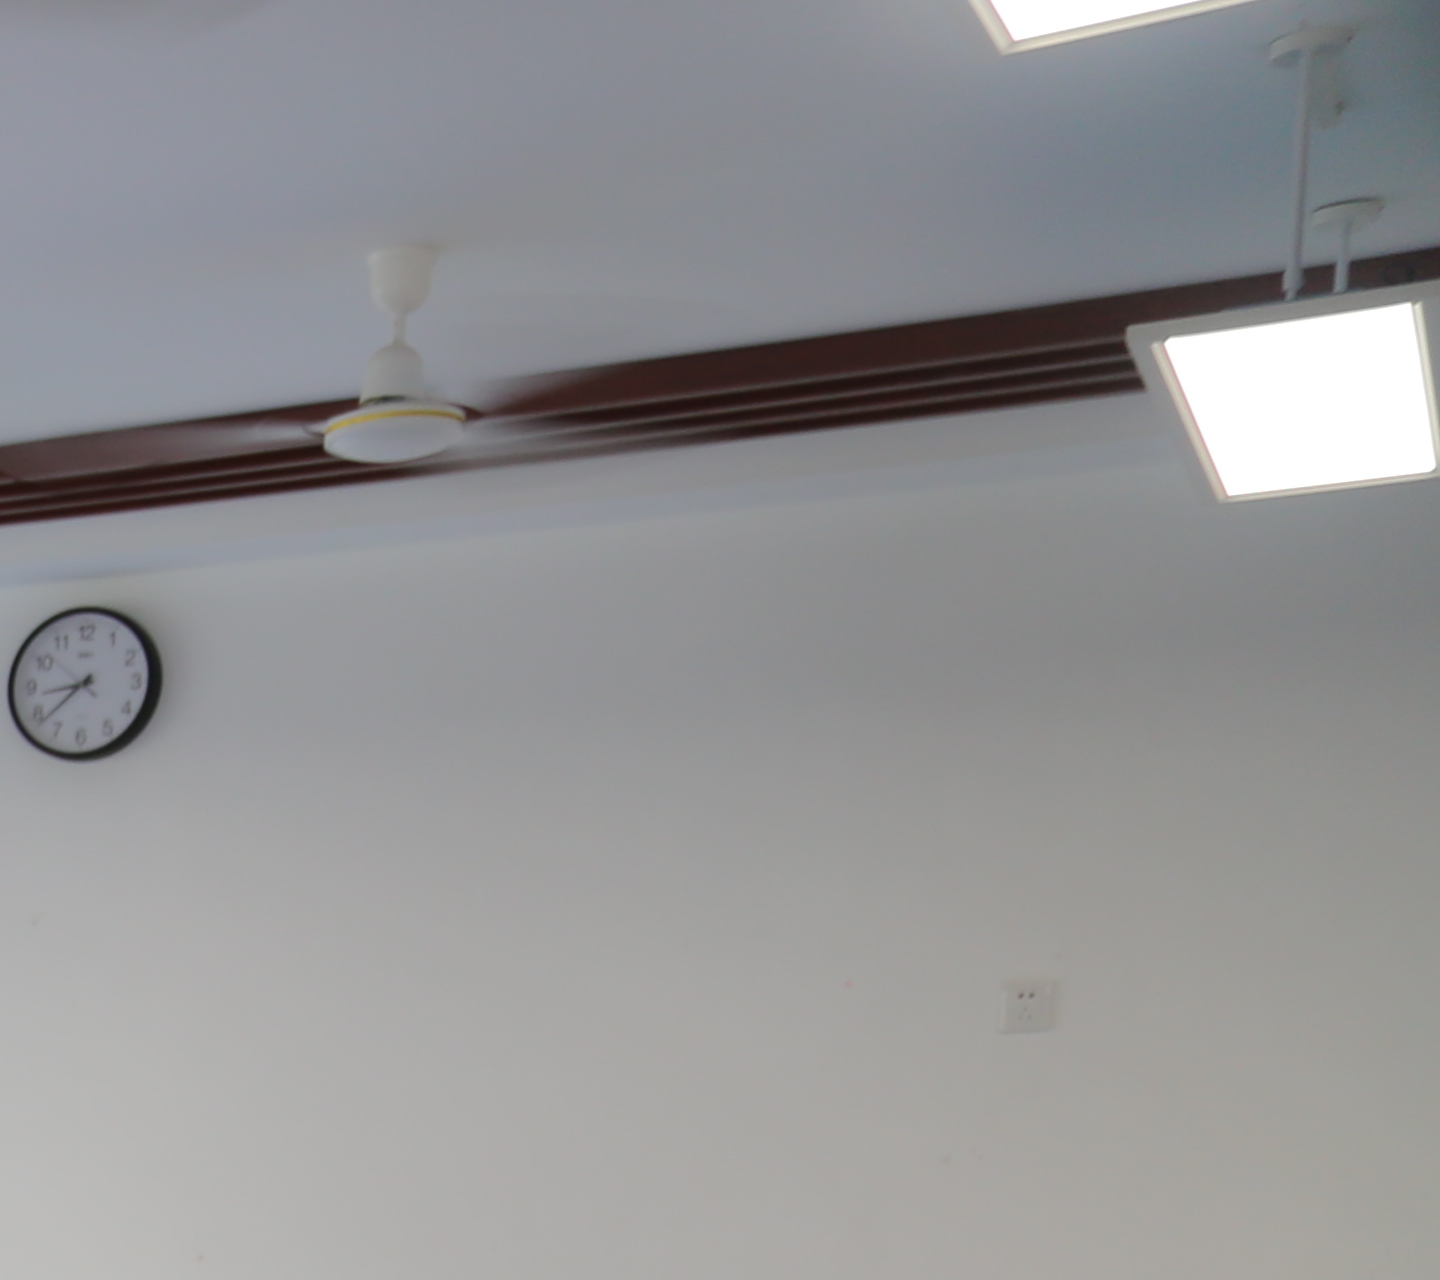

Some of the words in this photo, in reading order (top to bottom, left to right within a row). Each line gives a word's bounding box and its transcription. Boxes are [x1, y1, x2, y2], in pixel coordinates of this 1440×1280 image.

[79, 624, 96, 642] 12
[110, 631, 117, 646] 1
[54, 634, 69, 650] 11
[36, 655, 53, 671] 10
[125, 651, 136, 667] 2
[26, 680, 37, 696] 9
[131, 674, 142, 691] 3
[33, 705, 45, 722] 8
[121, 701, 132, 716] 4
[52, 721, 63, 738] 7
[102, 719, 114, 737] 5
[75, 729, 87, 746] 6
